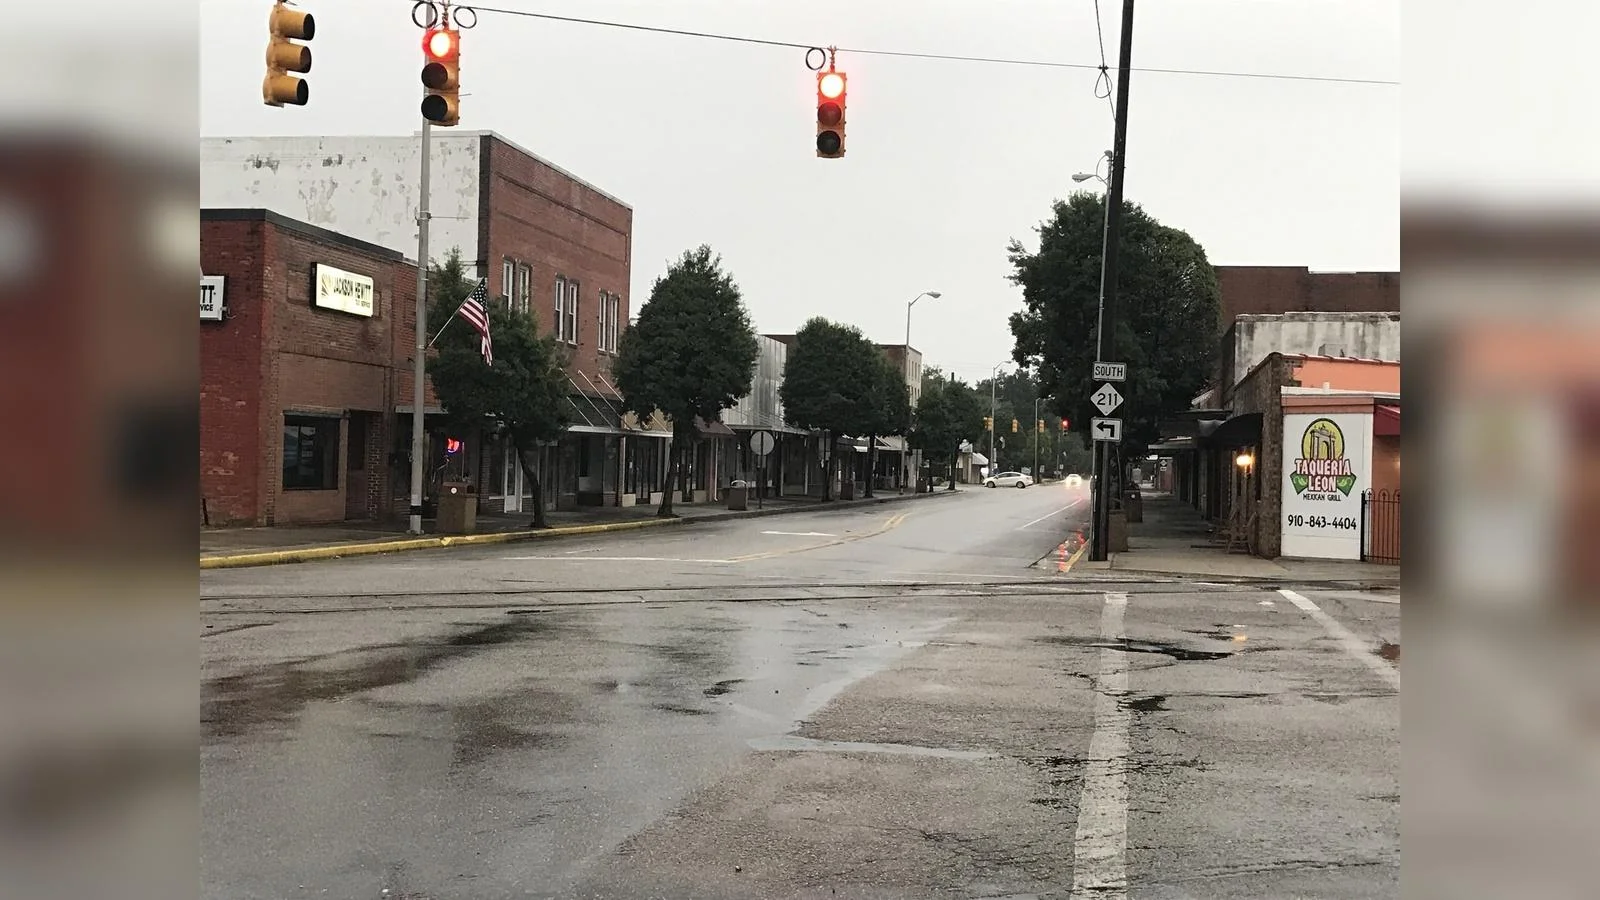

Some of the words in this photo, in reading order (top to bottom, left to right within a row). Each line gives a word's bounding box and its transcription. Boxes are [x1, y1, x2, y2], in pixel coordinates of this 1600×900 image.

[1095, 365, 1123, 377] SOUTH
[1097, 392, 1117, 406] 211
[1308, 475, 1336, 491] LEON
[1287, 514, 1357, 530] 910-843-4404
